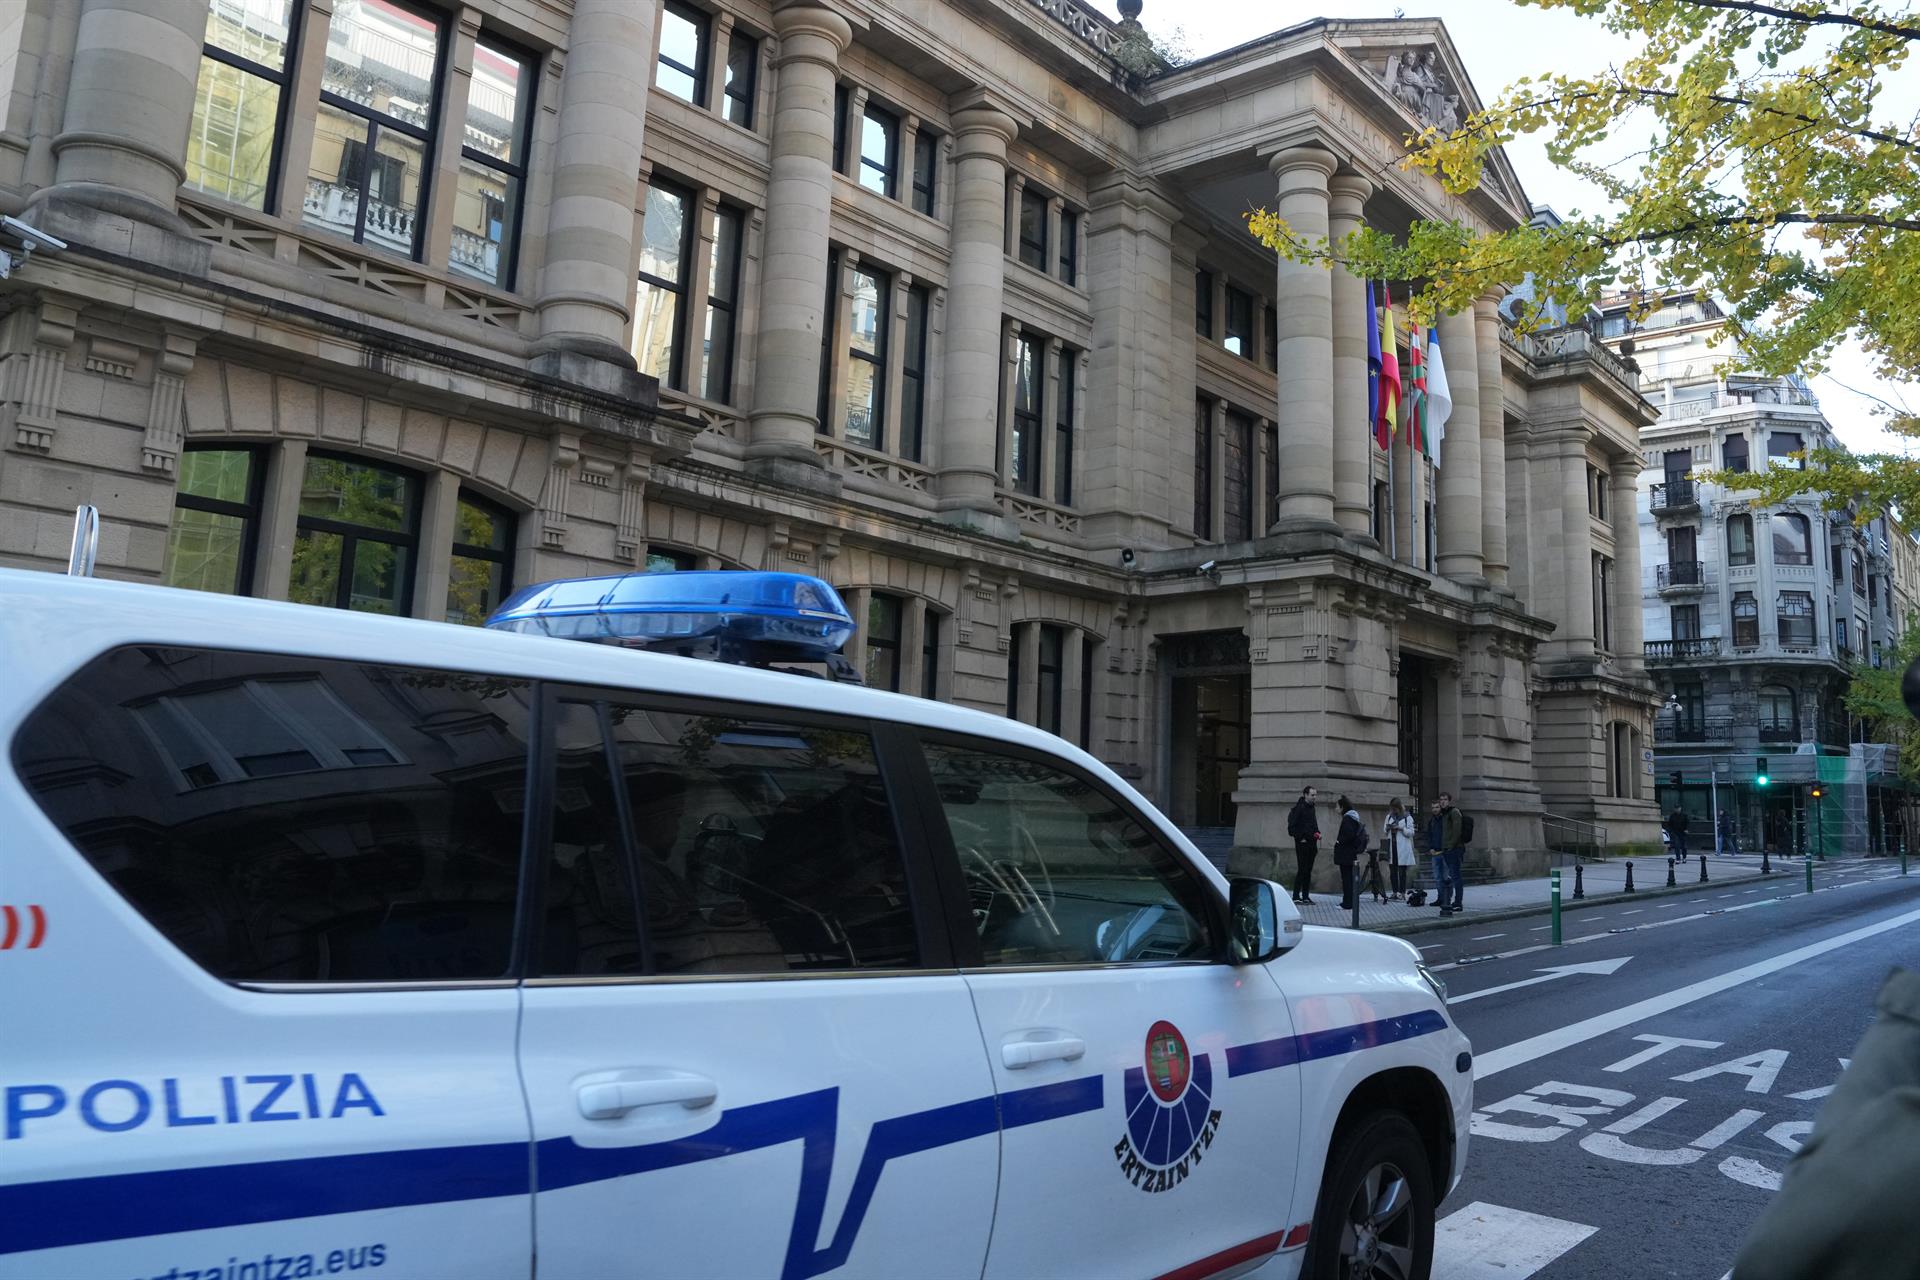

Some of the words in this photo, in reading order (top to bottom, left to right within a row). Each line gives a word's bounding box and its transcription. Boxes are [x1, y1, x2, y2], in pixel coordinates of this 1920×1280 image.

[1327, 91, 1397, 164] PALACIO
[1411, 167, 1426, 193] DE
[3, 1072, 387, 1140] POLIZIA
[1113, 1109, 1222, 1194] ERTZAINTZA
[130, 1242, 387, 1280] aintza.eus
